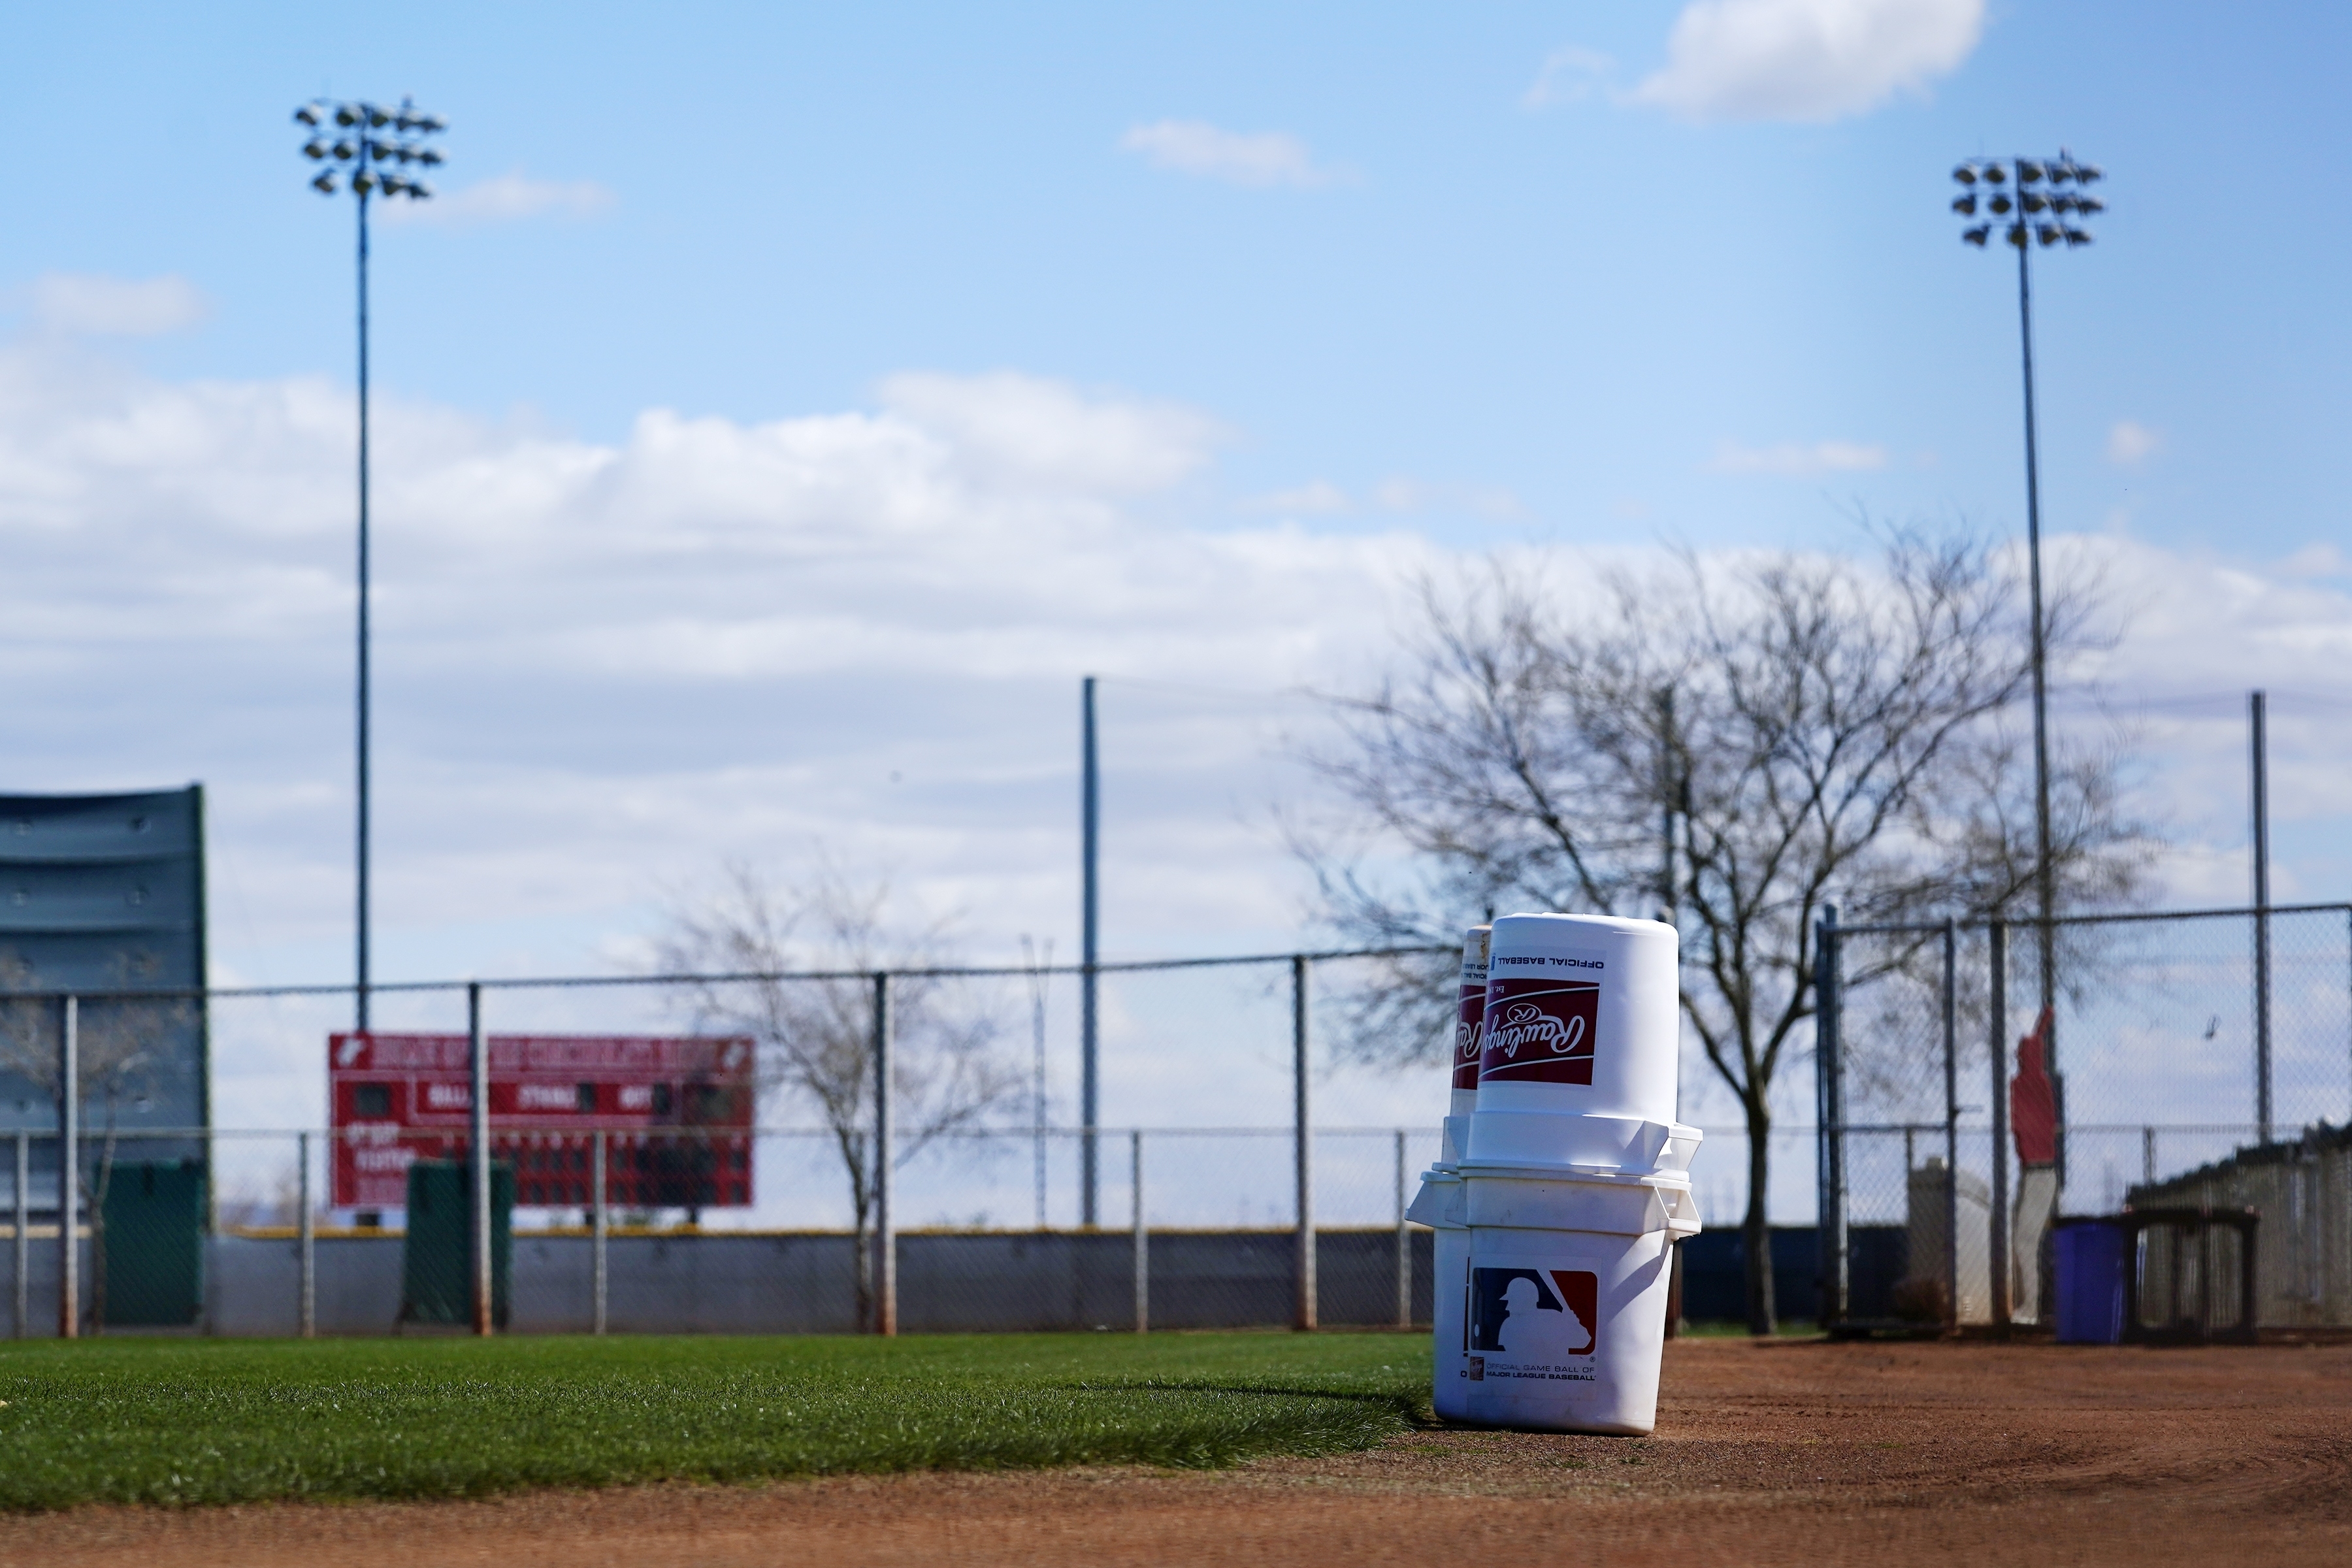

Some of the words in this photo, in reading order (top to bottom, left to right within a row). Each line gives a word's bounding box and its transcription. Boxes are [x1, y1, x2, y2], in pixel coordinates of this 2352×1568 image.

[1498, 956, 1545, 966] BASEBALL
[1549, 958, 1604, 969] OFFICIAL
[1484, 1014, 1585, 1058] Rawlings
